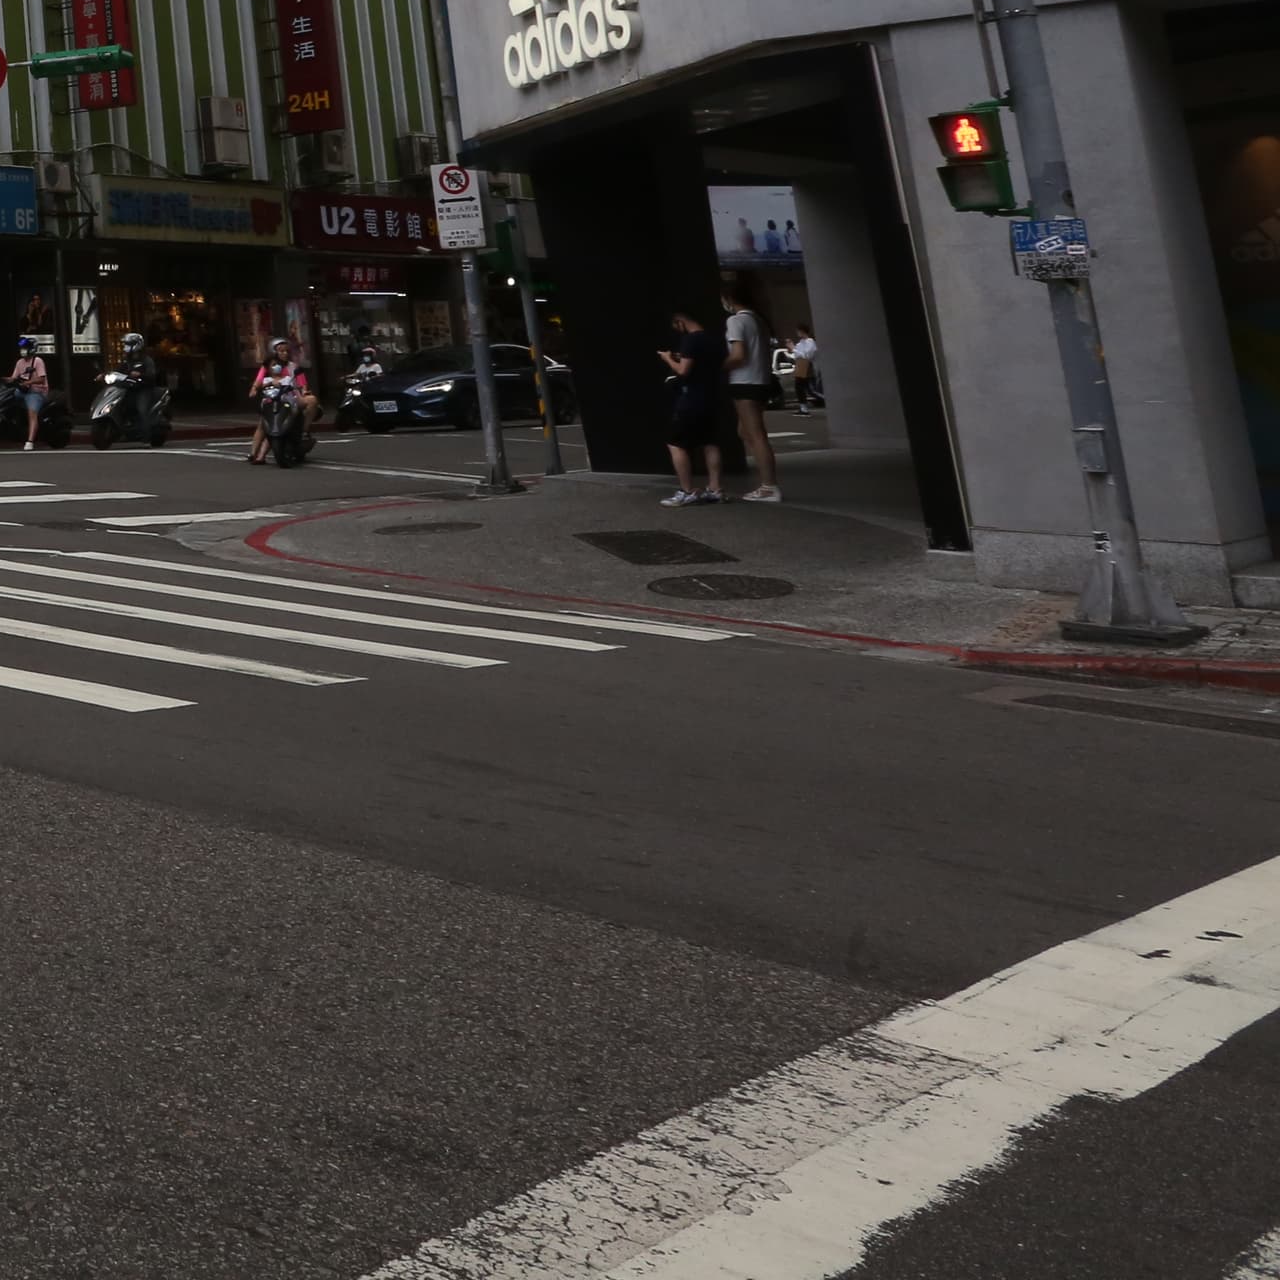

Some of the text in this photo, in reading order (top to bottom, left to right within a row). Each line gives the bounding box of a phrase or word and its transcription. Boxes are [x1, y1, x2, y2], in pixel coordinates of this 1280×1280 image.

[288, 90, 331, 114] 24H
[15, 208, 35, 231] 6F
[320, 205, 358, 236] U2
[363, 208, 422, 240] 電影館
